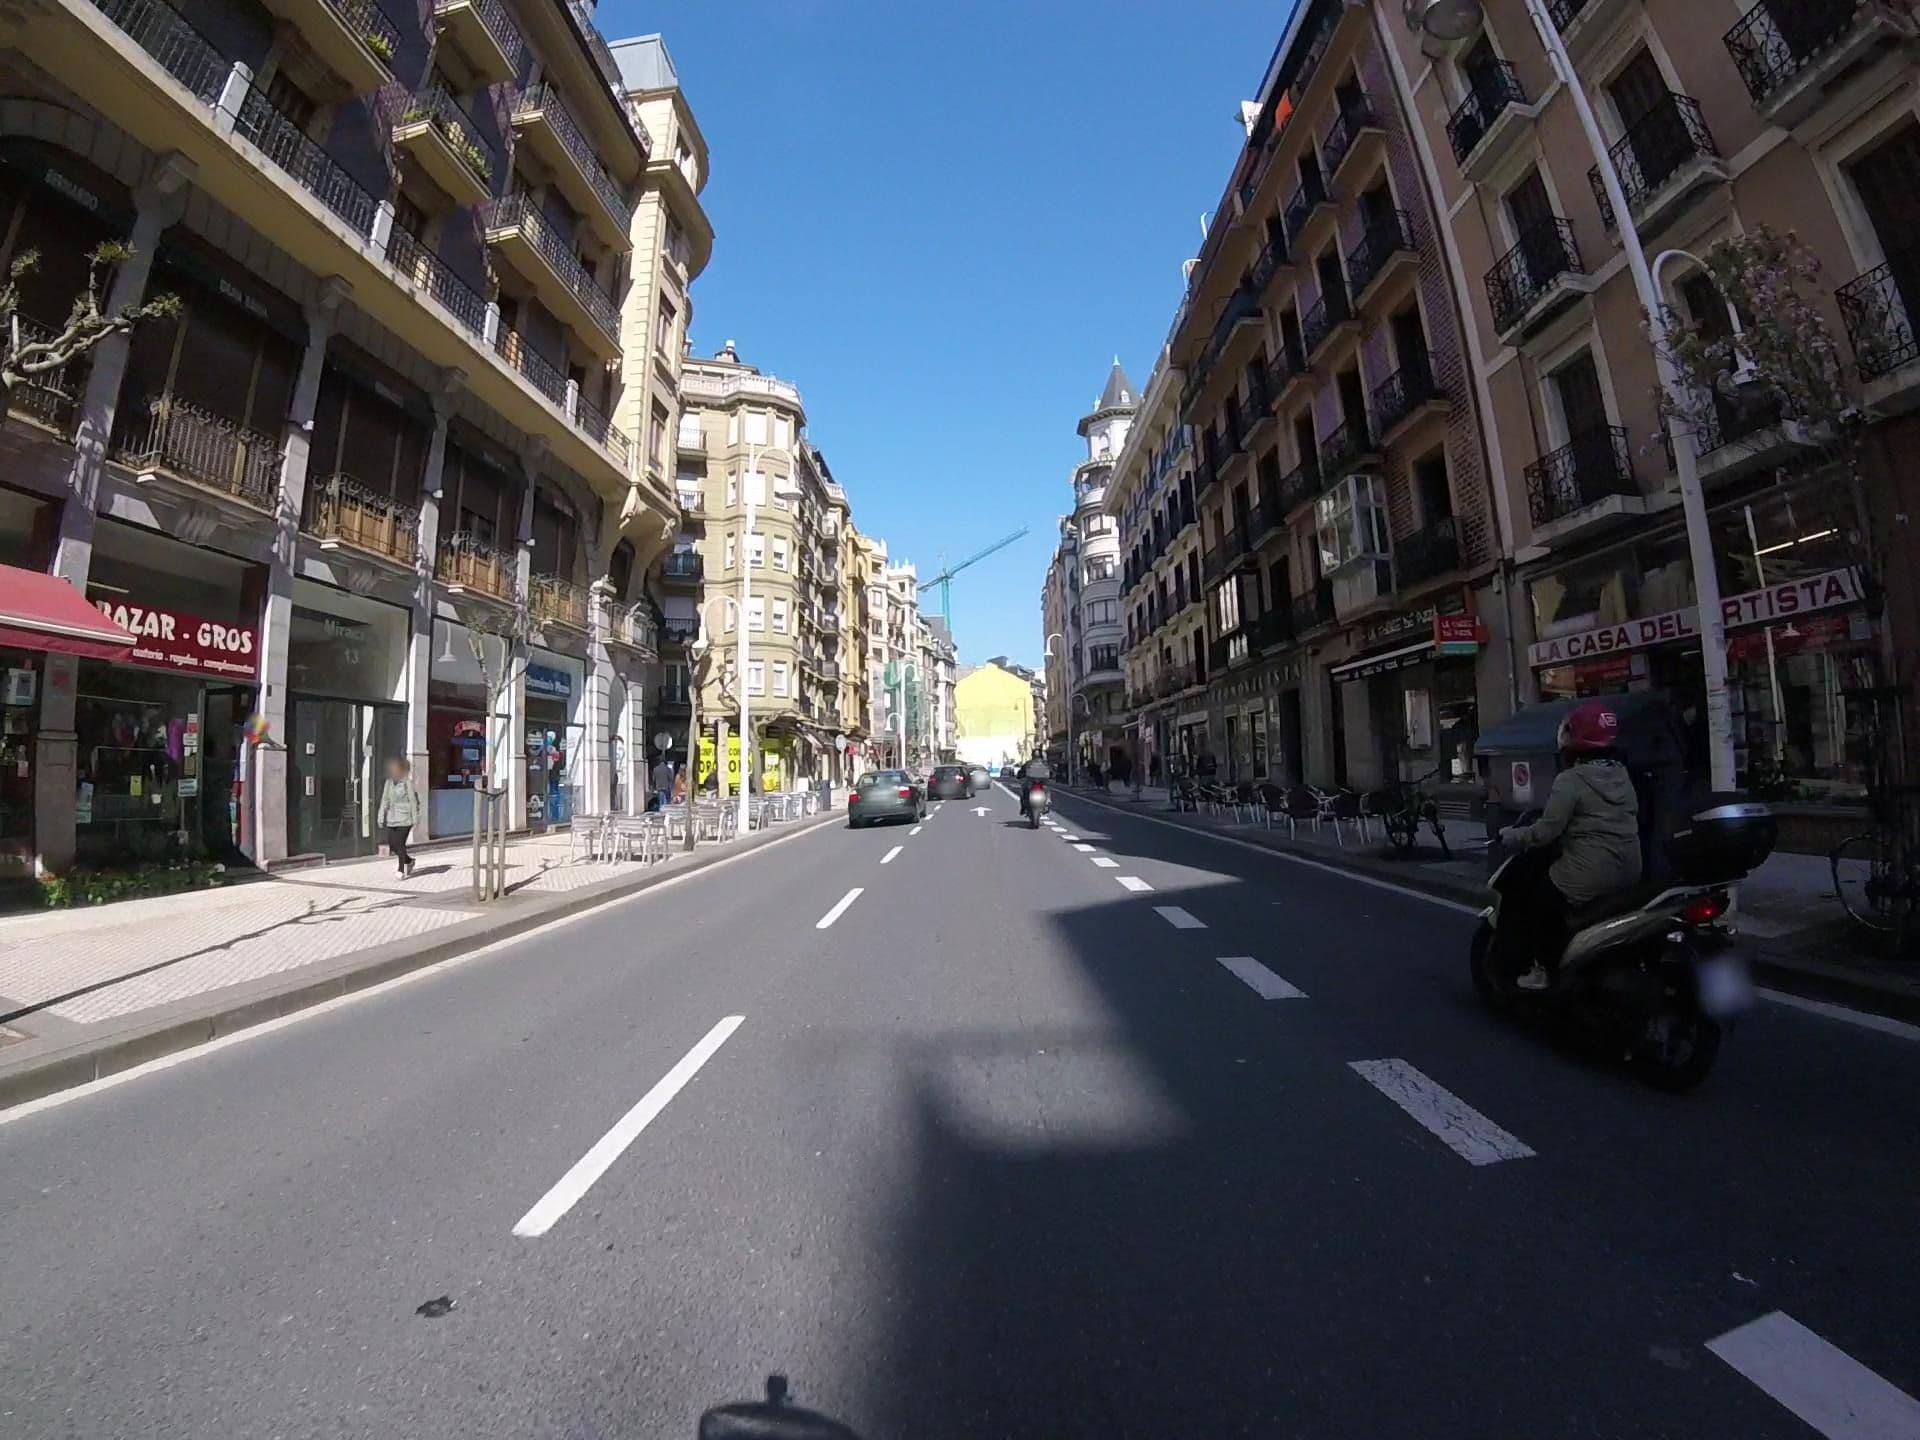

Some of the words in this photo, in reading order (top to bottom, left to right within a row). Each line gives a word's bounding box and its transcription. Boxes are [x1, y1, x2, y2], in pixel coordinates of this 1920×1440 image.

[197, 623, 252, 654] GROS
[1535, 642, 1562, 662] LA
[1567, 628, 1631, 657] CASA
[1640, 613, 1692, 643] DEL
[1721, 575, 1847, 626] RTISTA
